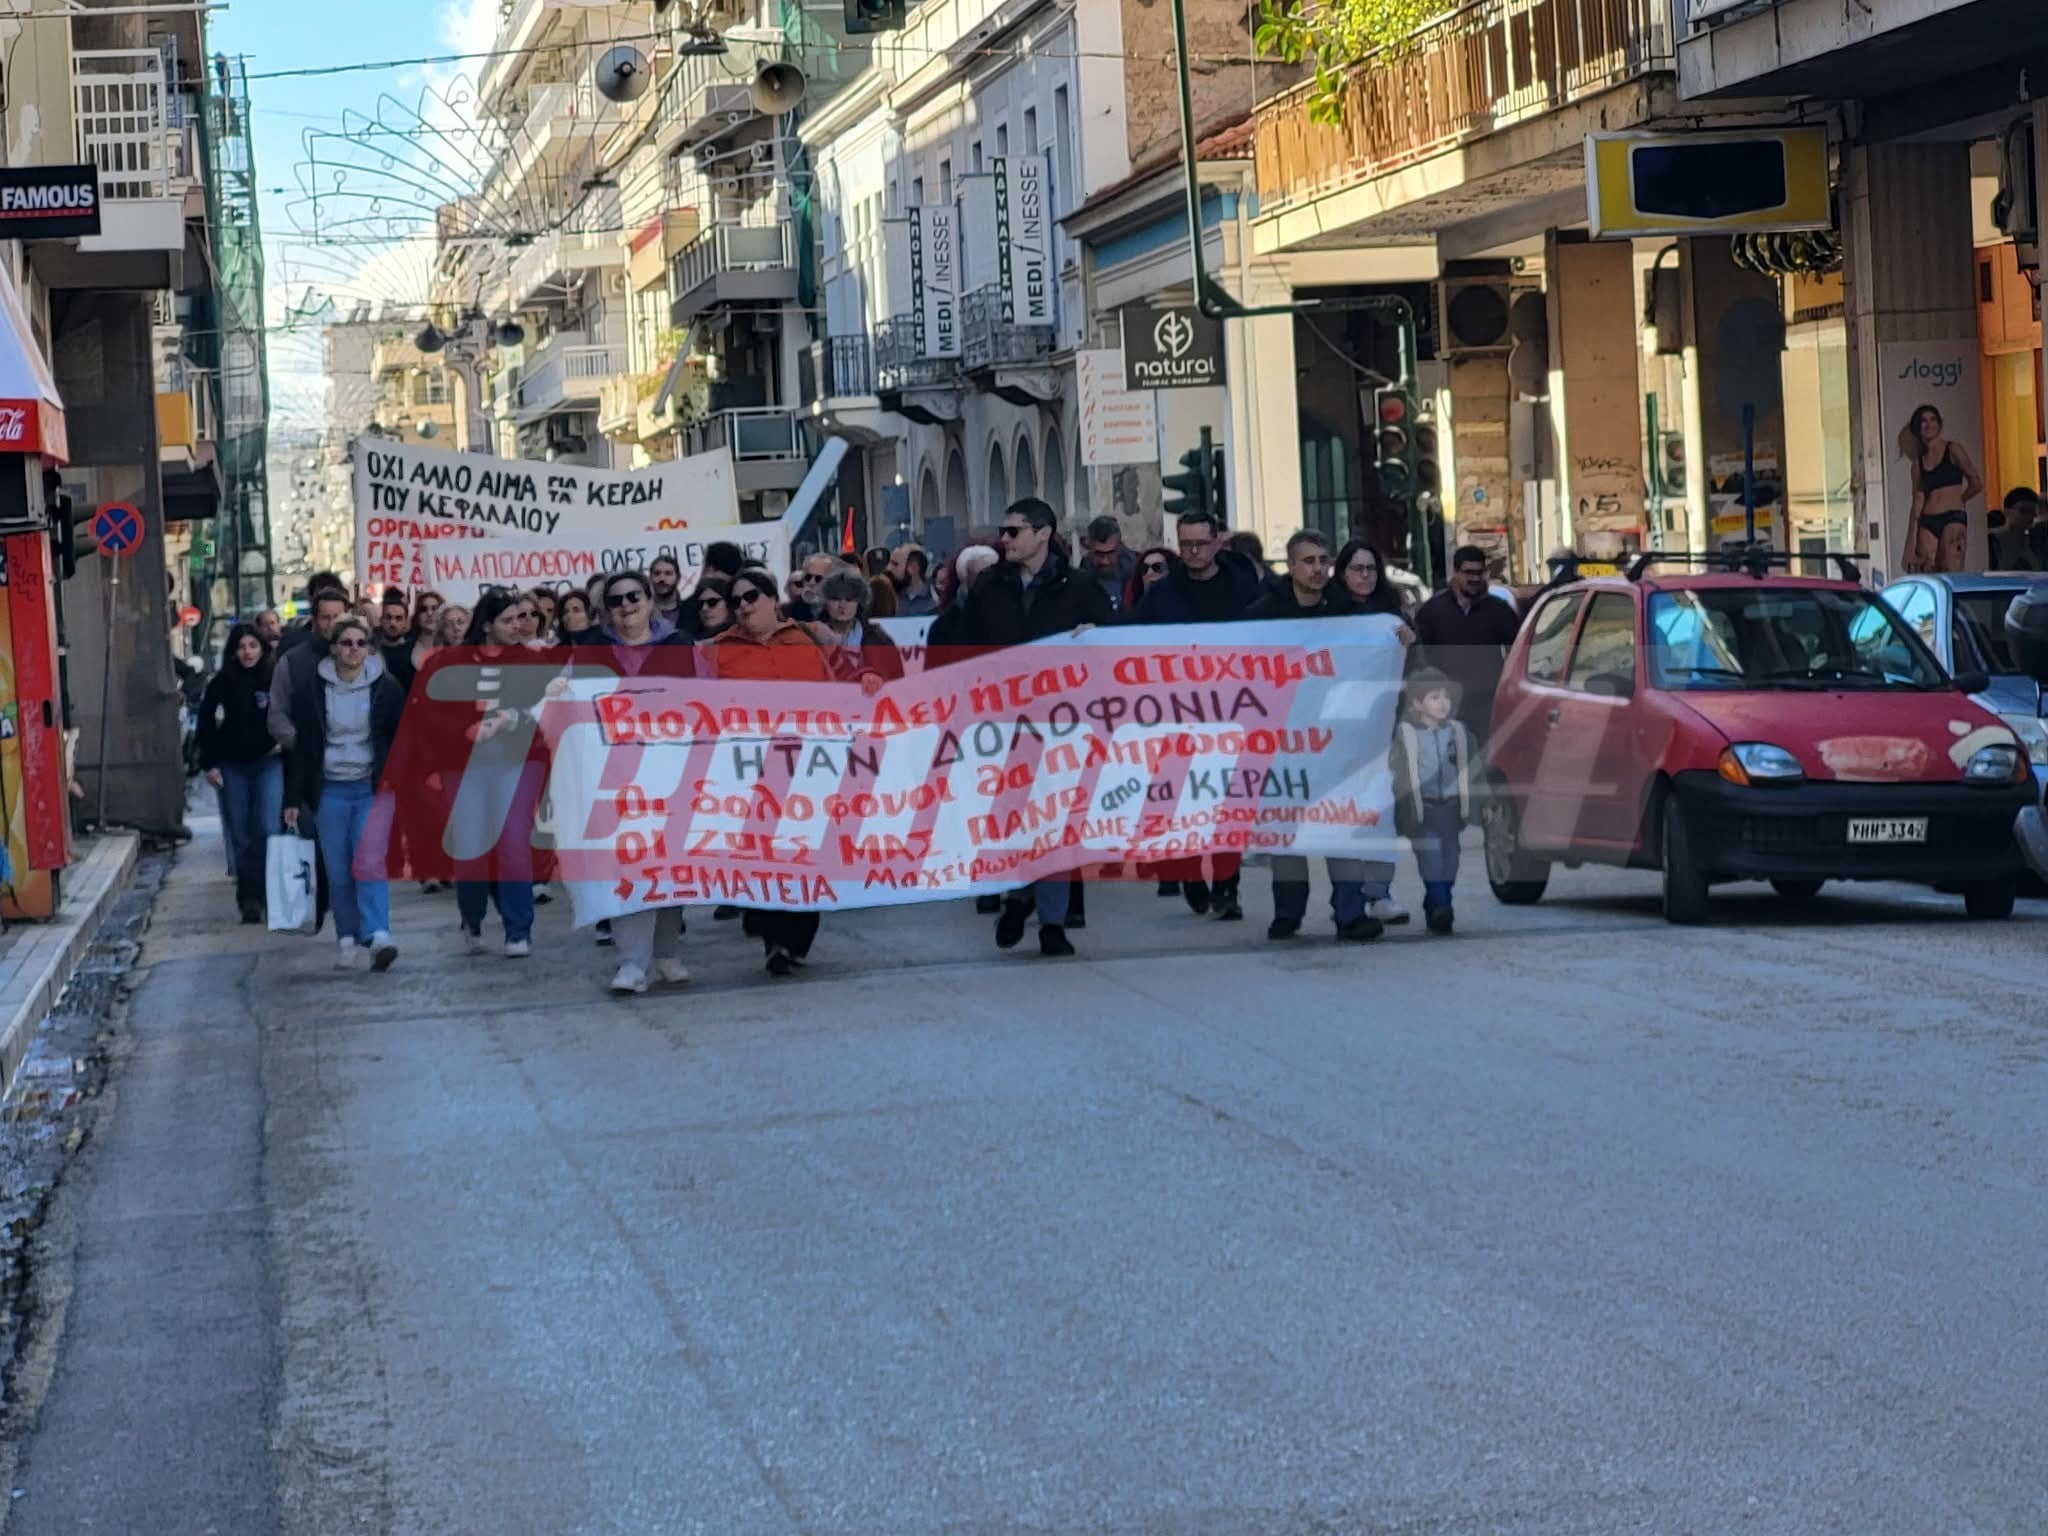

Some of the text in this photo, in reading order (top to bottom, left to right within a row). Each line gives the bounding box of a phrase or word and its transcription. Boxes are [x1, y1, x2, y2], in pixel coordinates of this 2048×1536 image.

[1, 184, 95, 210] FAMOUS
[1134, 356, 1216, 377] natural
[1899, 357, 1963, 387] sloggi
[367, 451, 664, 507] ΟΧΙ ΑΛΛΟ ΑΙΜΑ ΓΙΑ ΤΑ ΚΕΡΔΗ
[368, 482, 561, 535] ΤΟΥ ΚΕΦΑΛΑΙΟΥ
[432, 553, 466, 582] ΝΑ
[471, 548, 596, 581] ΑΠΟΔΟΘΟΥΝ
[869, 694, 957, 739] Δεν
[968, 660, 1089, 714] ήταν
[1112, 644, 1337, 689] ατύχημα
[732, 687, 1269, 781] ΗΤΑΝ ΔΟΛΟΦΟΝΙΑ
[613, 784, 673, 821] Οι
[976, 761, 1035, 797] θα
[613, 830, 668, 866] ΟΙ
[688, 829, 816, 866] ΖΩΕΣ
[838, 829, 943, 866] ΜΑΣ
[967, 784, 1089, 846] ΠΑΝΩ
[1145, 780, 1174, 802] τα
[1188, 767, 1310, 801] ΚΕΡΔΗ
[641, 865, 839, 904] ΣΩΜΑΤΕΙΑ
